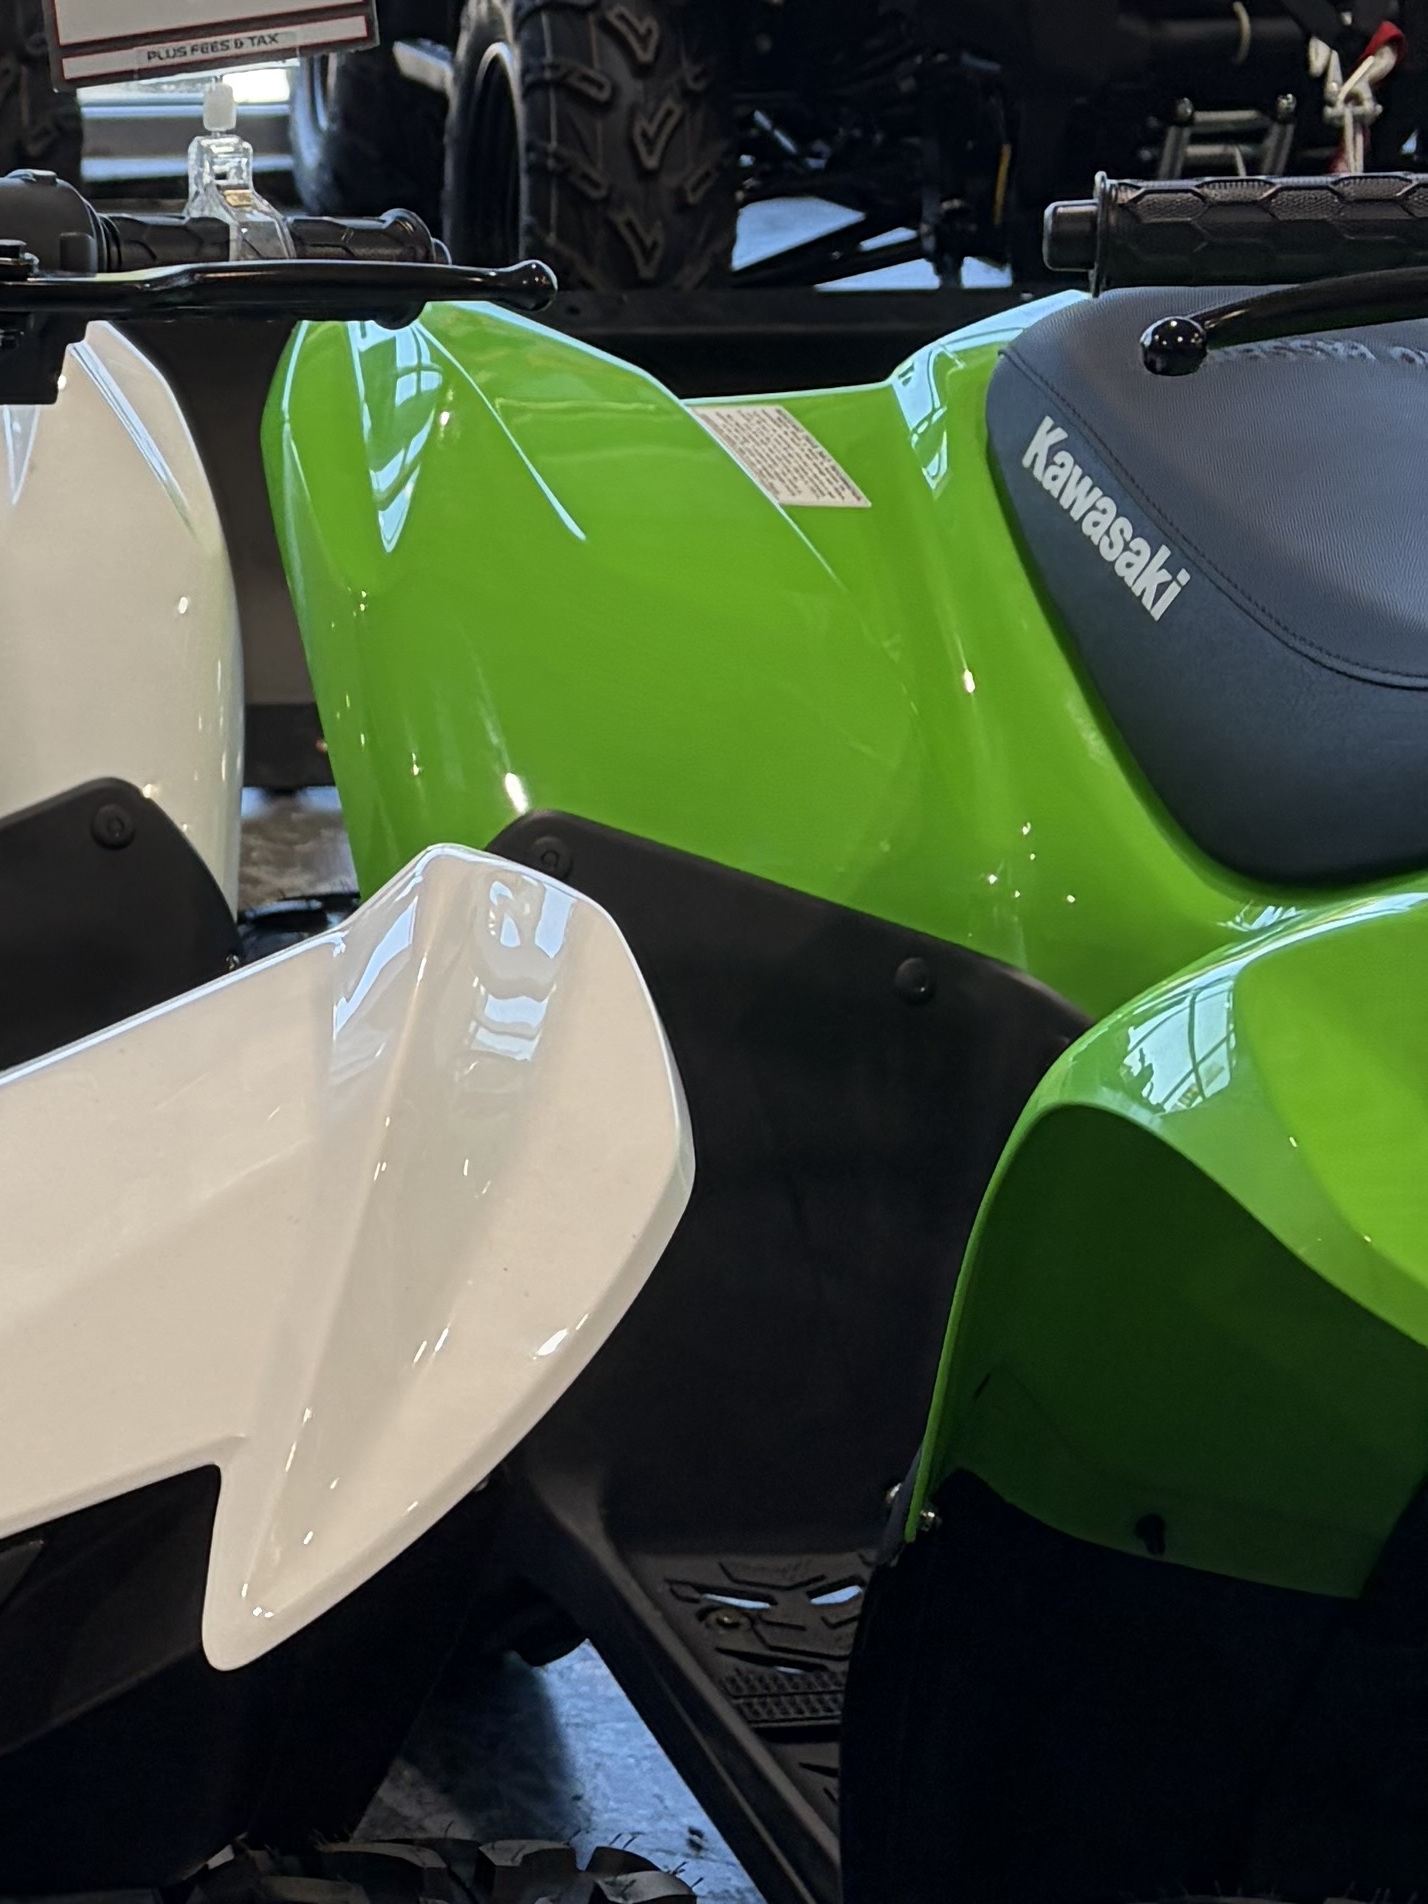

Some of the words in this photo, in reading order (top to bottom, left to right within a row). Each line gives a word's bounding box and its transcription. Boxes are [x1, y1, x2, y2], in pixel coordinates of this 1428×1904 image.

[147, 46, 188, 61] PLUS
[190, 39, 231, 56] FEES
[245, 32, 280, 48] TAX
[1021, 415, 1191, 622] Kawasaki
